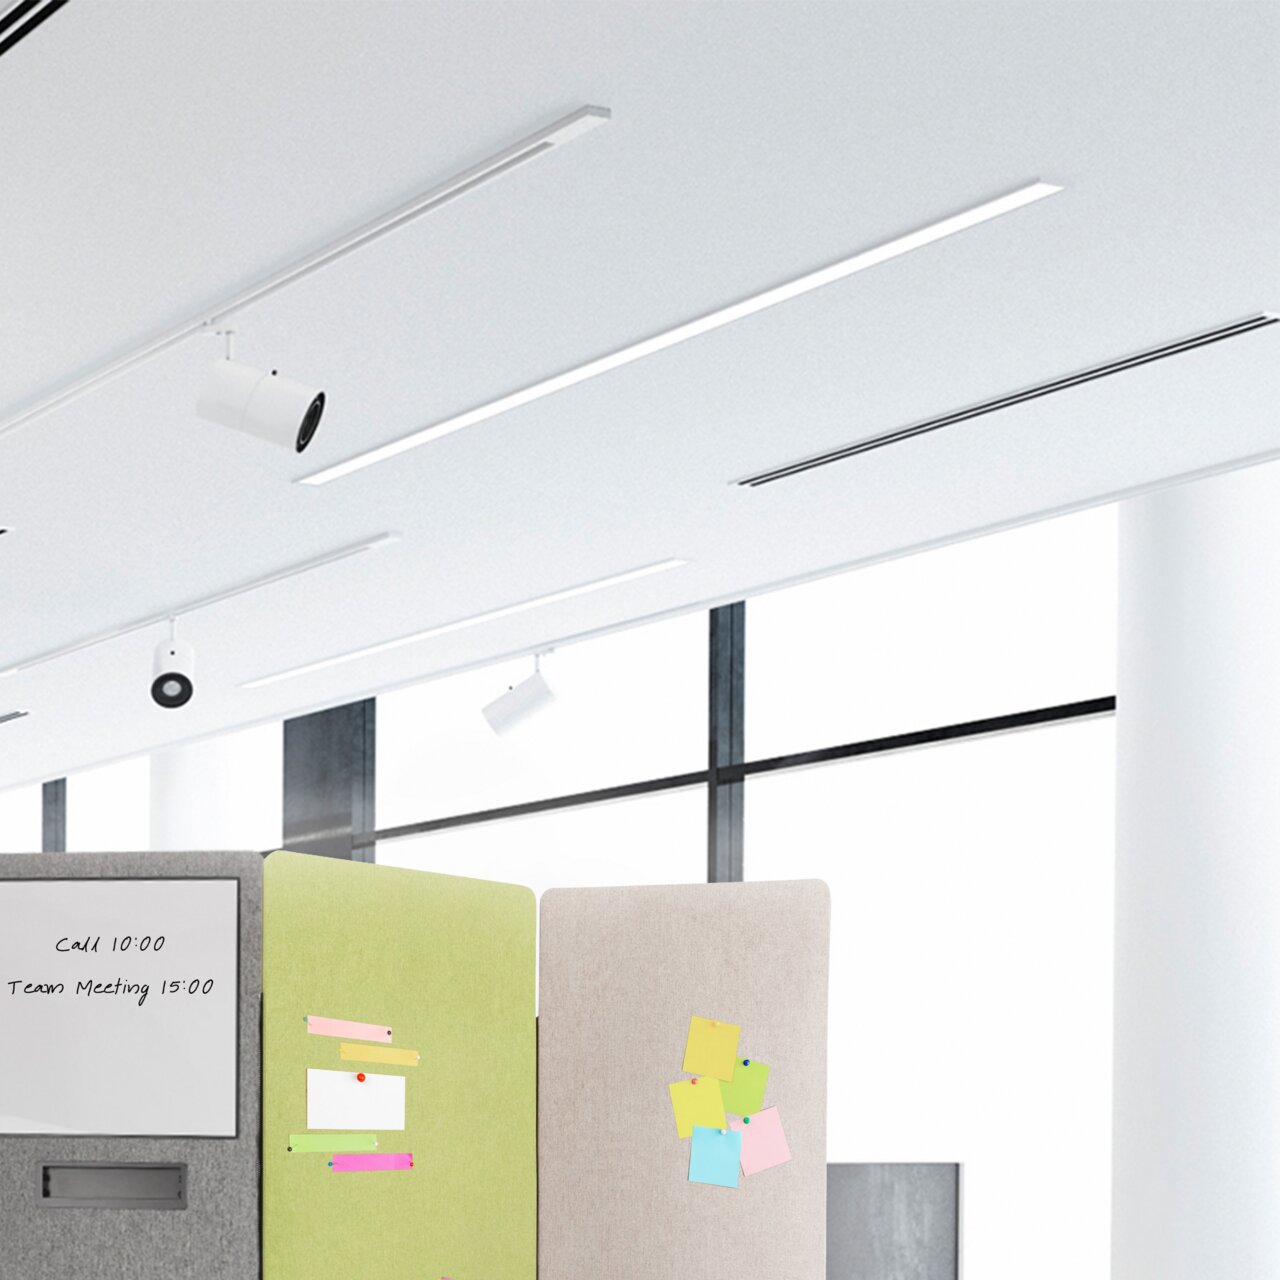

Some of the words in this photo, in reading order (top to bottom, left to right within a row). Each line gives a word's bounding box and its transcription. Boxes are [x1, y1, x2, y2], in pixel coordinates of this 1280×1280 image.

[55, 936, 101, 953] Call
[112, 935, 166, 952] 10:00
[7, 979, 65, 995] Team
[76, 978, 150, 1007] Meeting
[161, 978, 215, 995] 15:00
